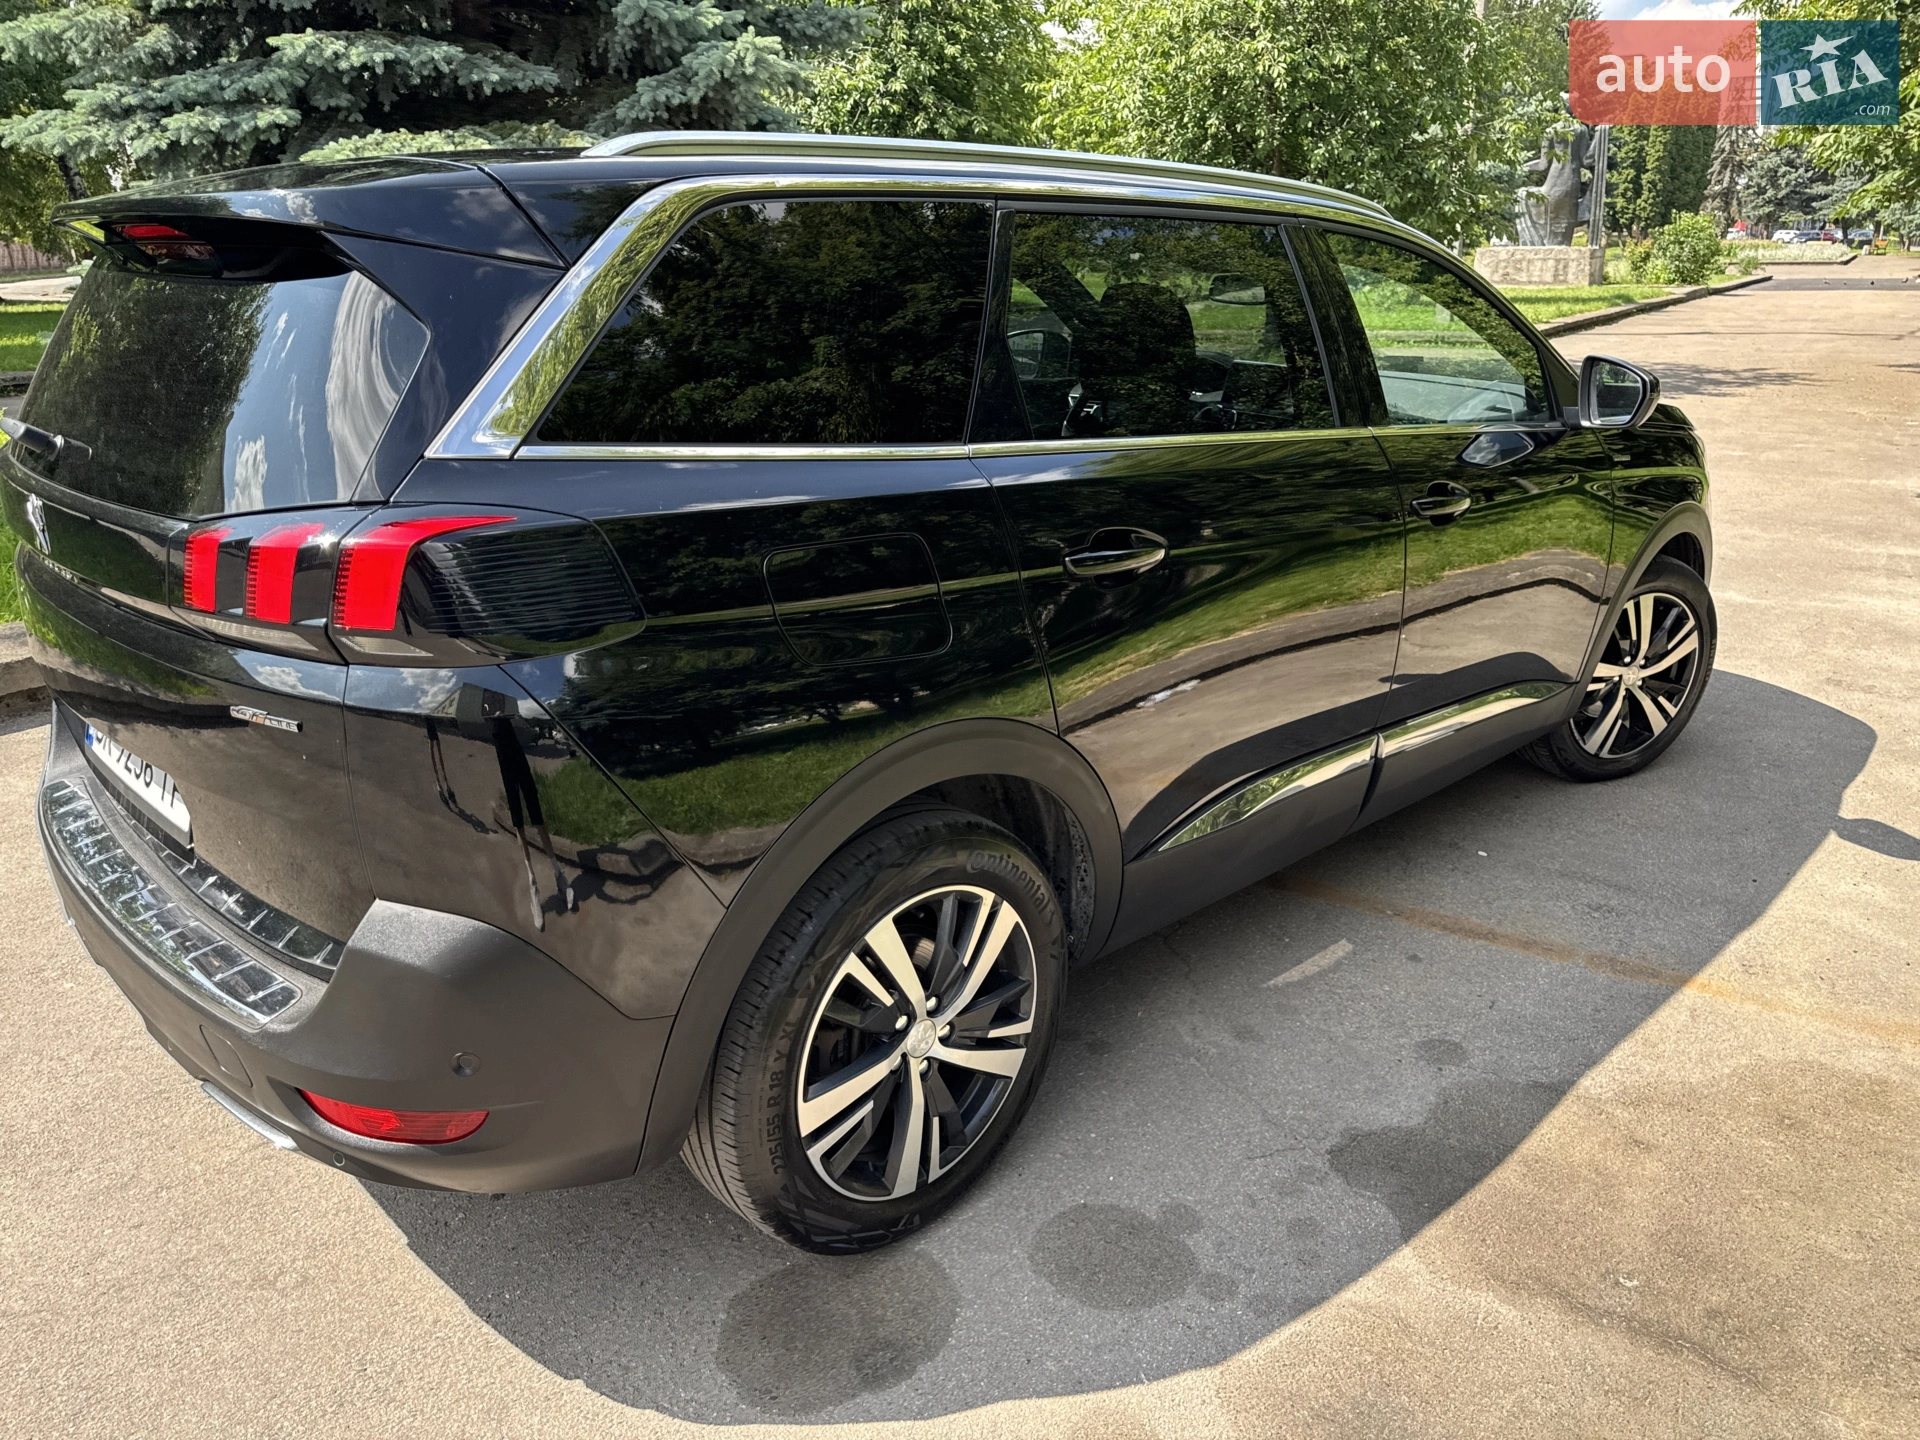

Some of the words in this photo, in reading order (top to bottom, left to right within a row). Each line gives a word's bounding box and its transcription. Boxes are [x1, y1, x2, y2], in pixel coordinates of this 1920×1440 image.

[966, 850, 1050, 914] Continental
[779, 1020, 798, 1041] XL
[774, 1050, 788, 1062] Y
[768, 1069, 784, 1091] 18
[767, 1094, 781, 1108] R
[766, 1114, 786, 1174] 225/55
